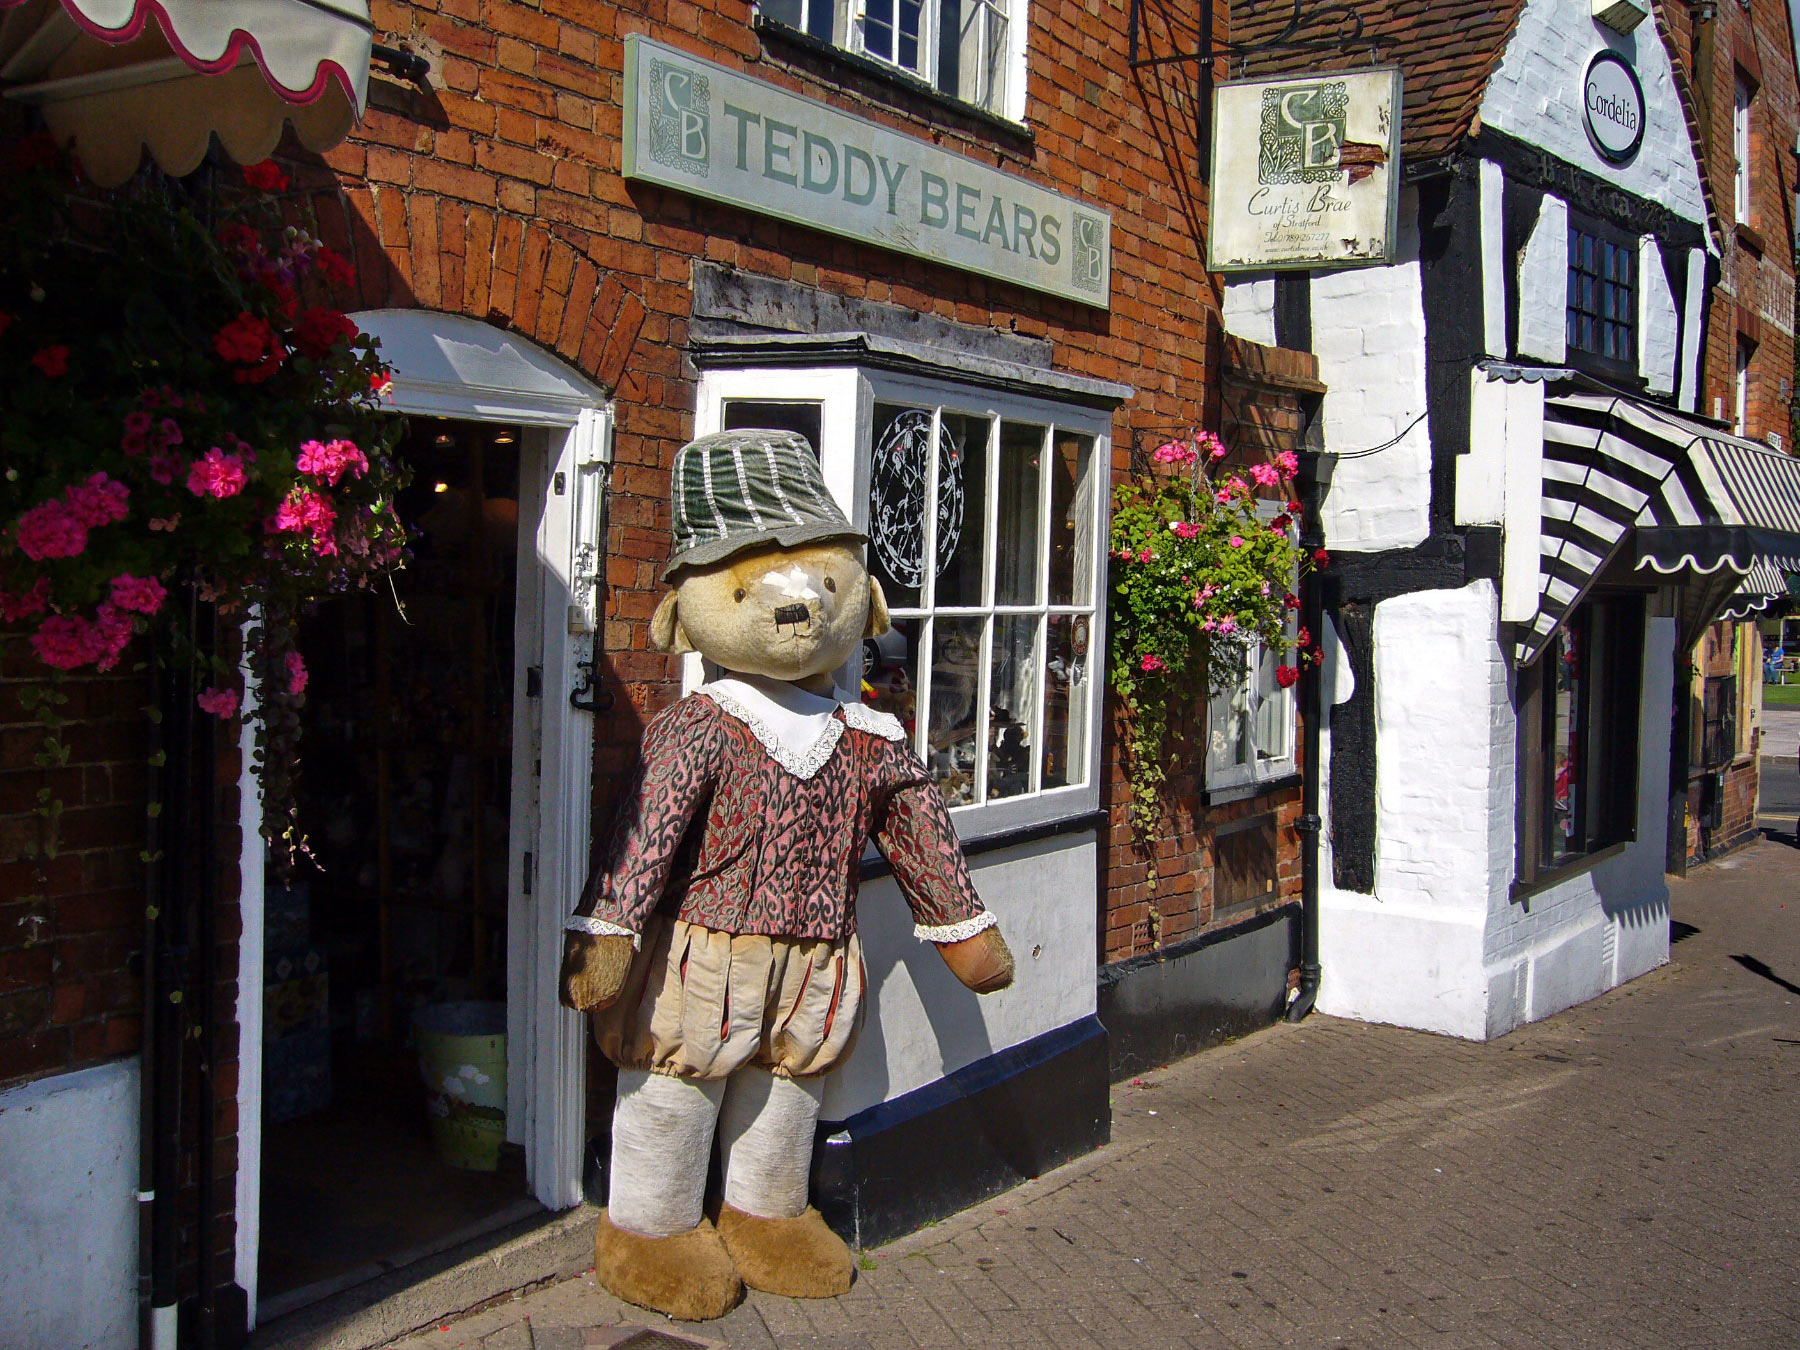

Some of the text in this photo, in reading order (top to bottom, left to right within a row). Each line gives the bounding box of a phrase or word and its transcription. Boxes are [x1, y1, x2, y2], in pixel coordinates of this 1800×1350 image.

[1586, 81, 1637, 131] Cordelia
[723, 103, 1063, 266] TEDDY BEARS
[1248, 184, 1352, 216] Curtis Brae
[1273, 214, 1321, 231] of Stratford
